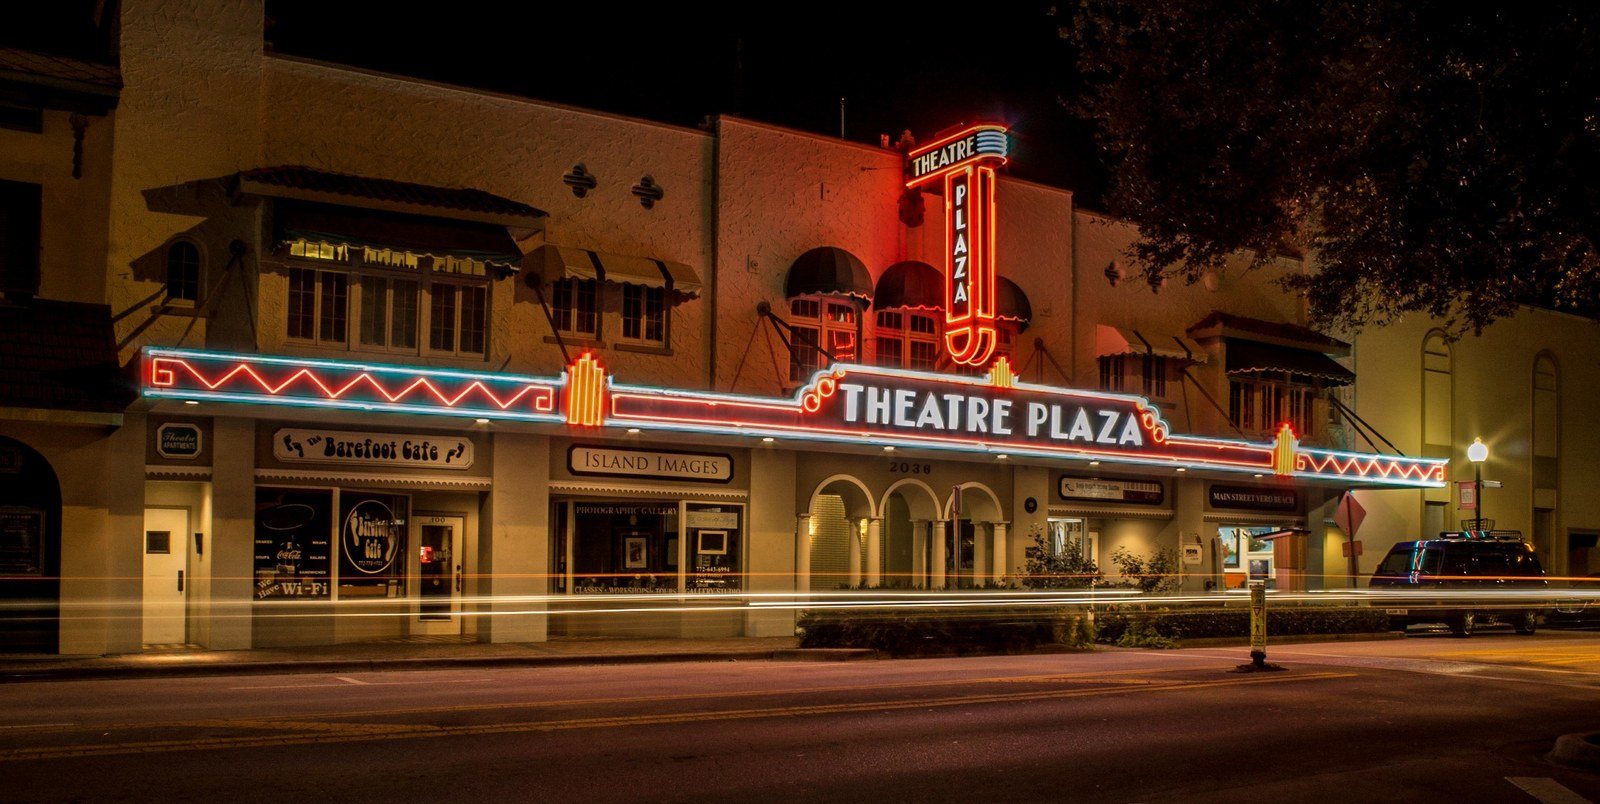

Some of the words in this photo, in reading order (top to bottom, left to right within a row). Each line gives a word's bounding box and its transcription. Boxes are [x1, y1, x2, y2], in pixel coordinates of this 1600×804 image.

[913, 136, 975, 177] THEATRE
[954, 184, 968, 304] PLAZA
[839, 384, 1012, 435] THEATRE
[1028, 402, 1143, 446] PLAZA
[163, 431, 196, 442] Theatre
[163, 441, 196, 450] APARTMENTS
[324, 437, 396, 459] Barefoot
[402, 440, 438, 461] Cafe
[889, 462, 931, 475] 2036
[1213, 492, 1231, 501] MAIN
[1231, 493, 1255, 502] STREET
[1255, 494, 1273, 503] VERO
[1273, 495, 1295, 504] BEACH
[576, 506, 640, 515] PHOTOGRAPHIC
[641, 507, 678, 515] GALLERY
[257, 579, 272, 589] We
[281, 582, 328, 595] Wi-Fi
[257, 584, 280, 599] Have
